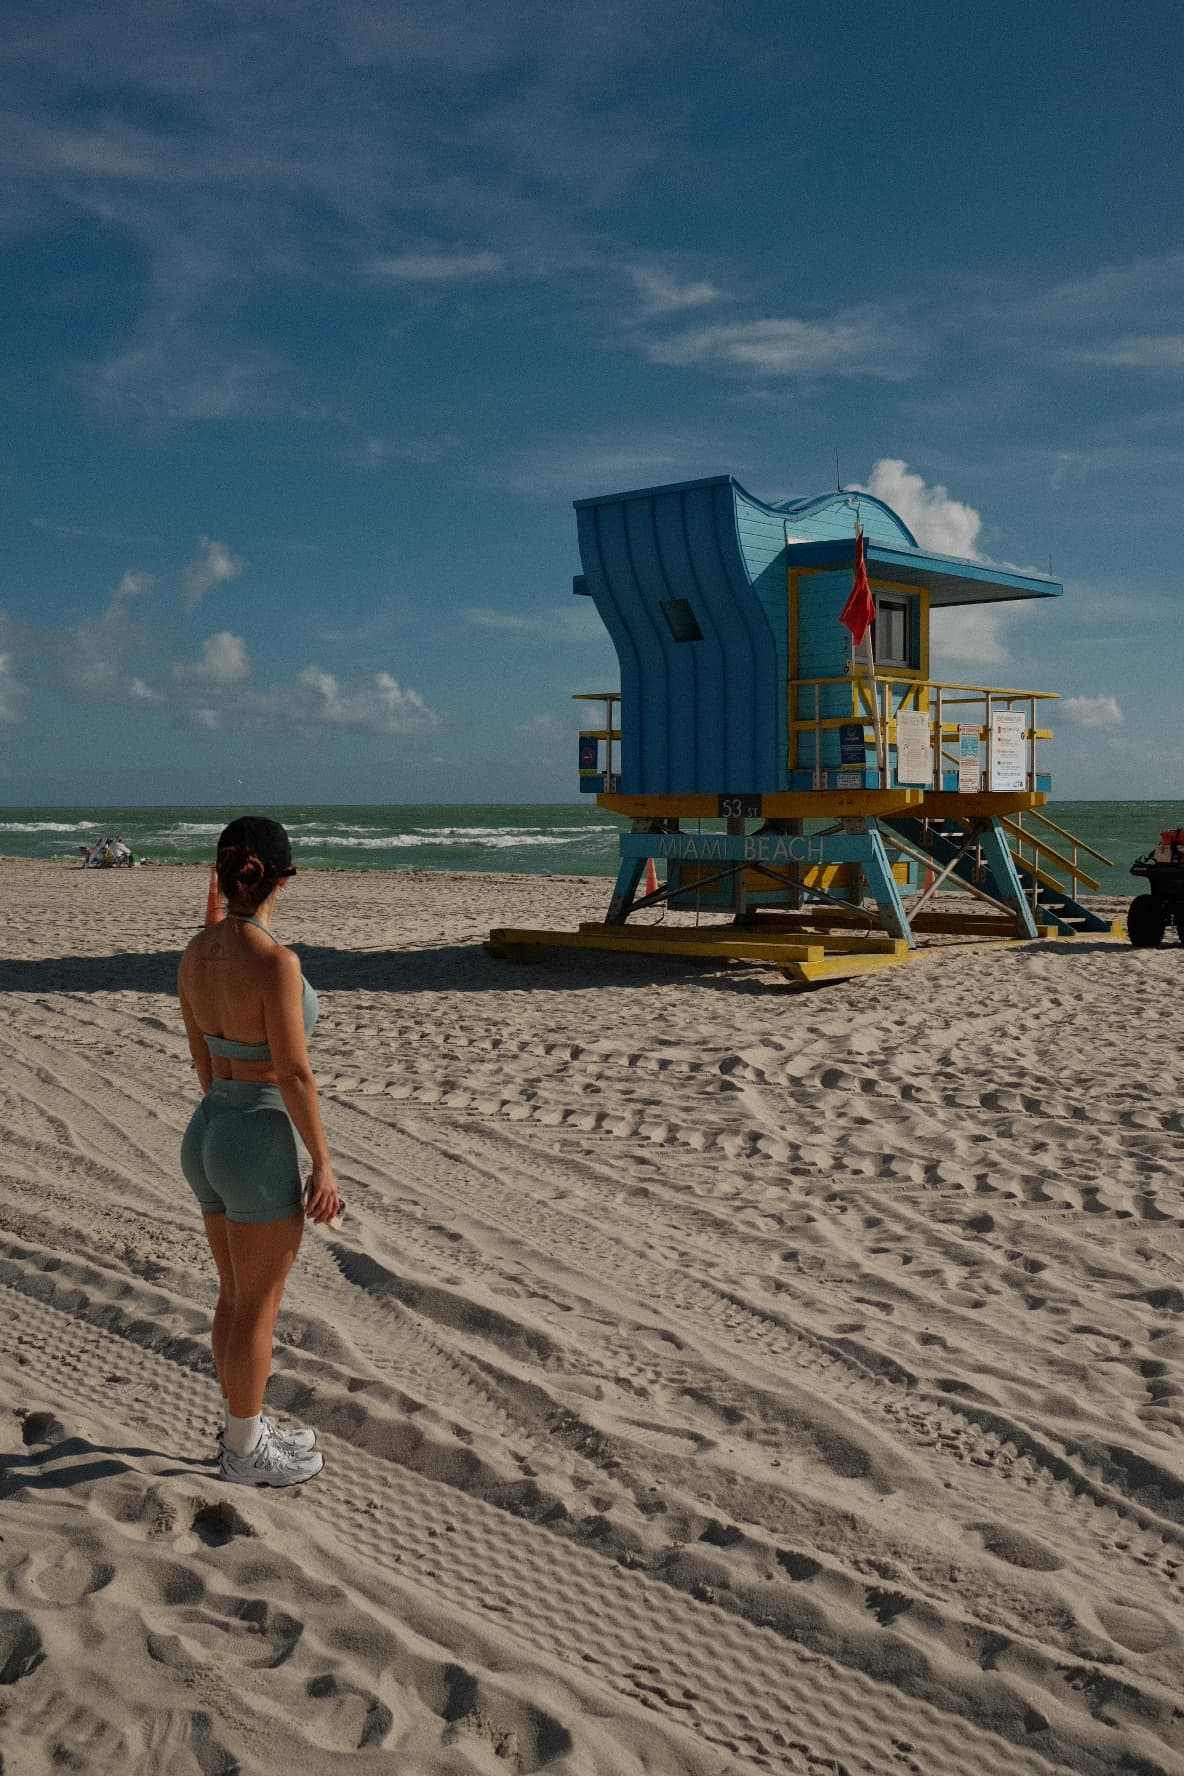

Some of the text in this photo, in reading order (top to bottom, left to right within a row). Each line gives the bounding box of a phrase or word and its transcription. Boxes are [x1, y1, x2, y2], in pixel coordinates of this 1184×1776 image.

[722, 799, 759, 818] 53 ST
[658, 837, 824, 861] MIAMI BEACH
